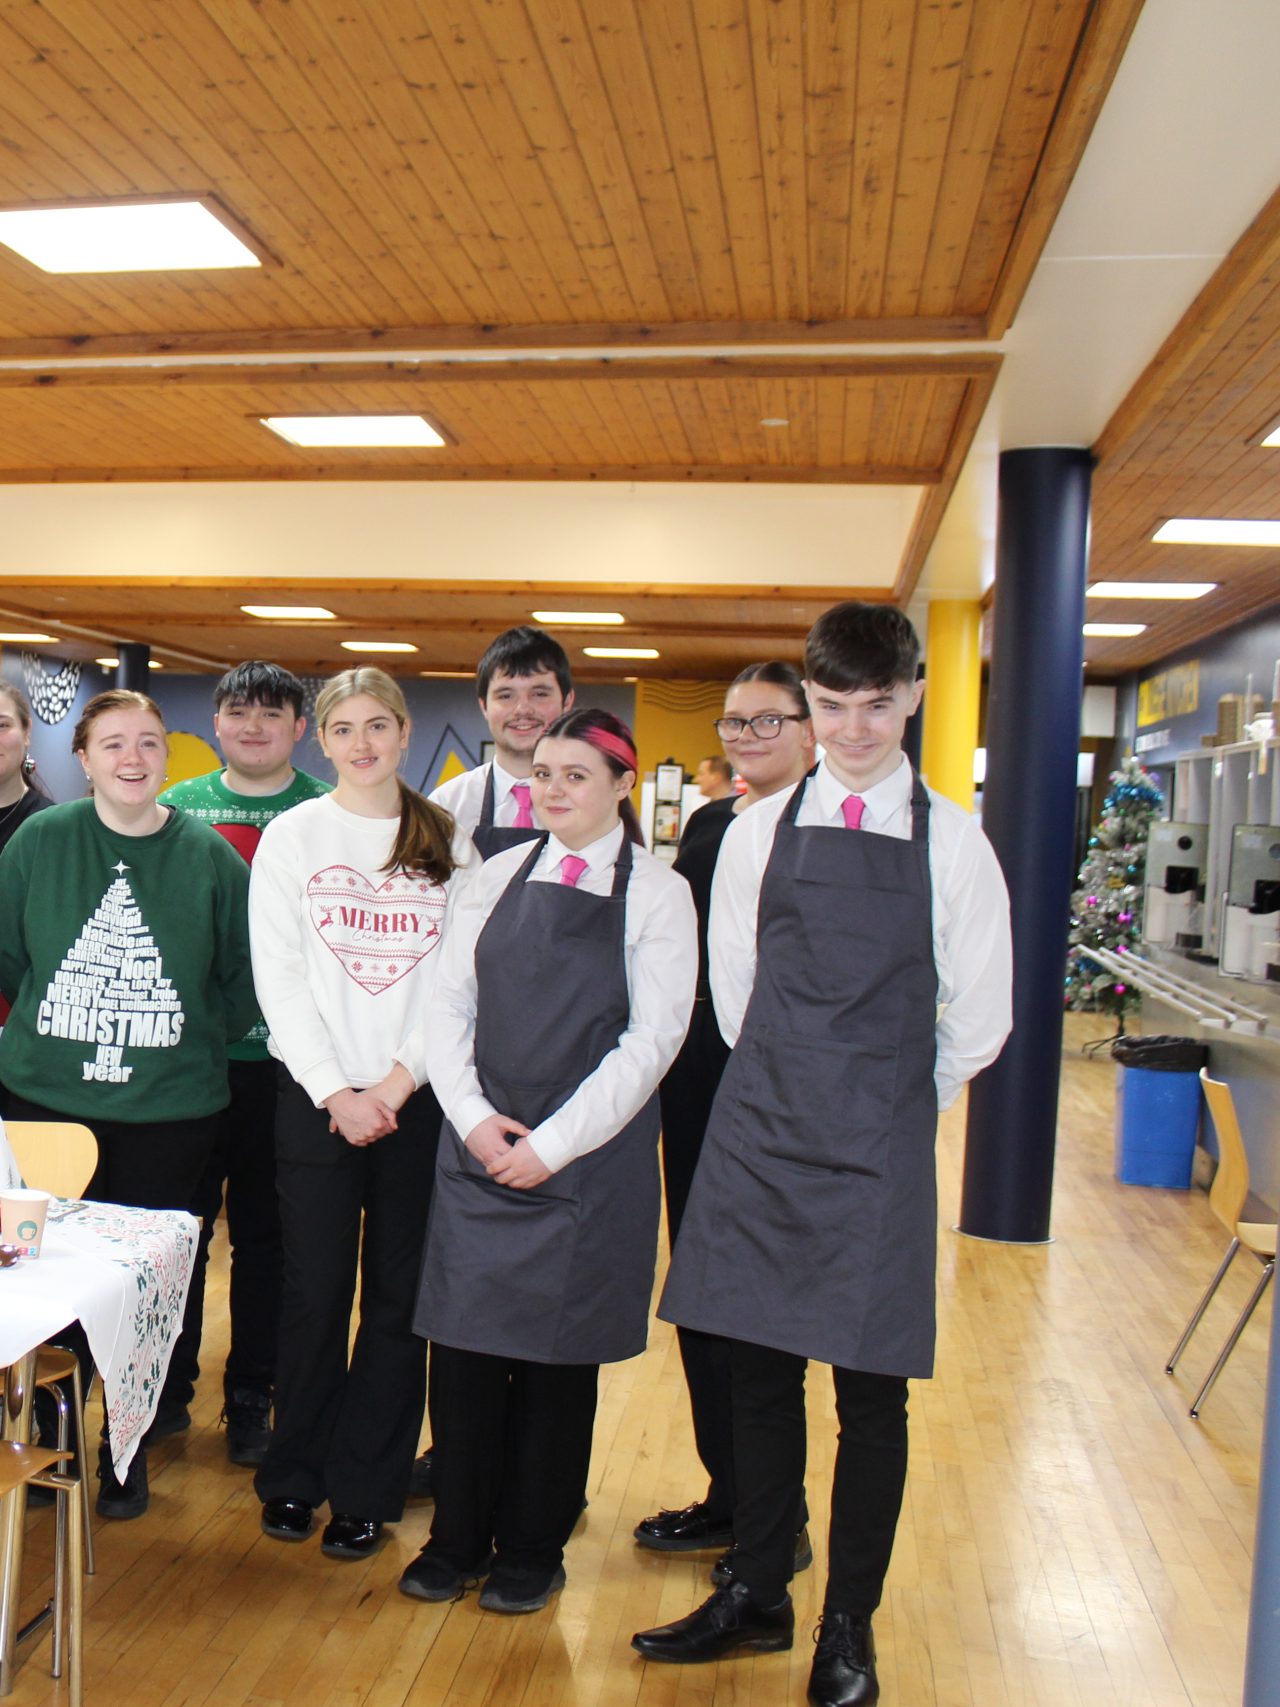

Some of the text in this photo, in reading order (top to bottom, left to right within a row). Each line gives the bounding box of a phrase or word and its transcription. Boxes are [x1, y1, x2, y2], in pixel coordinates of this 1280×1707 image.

[339, 906, 423, 933] MERRY
[74, 938, 108, 954] MERRY
[352, 928, 405, 942] Christmas
[67, 948, 162, 980] CHRISTMAS Noel
[54, 970, 106, 990] HOLIDAYS
[131, 979, 154, 990] LOVE
[46, 983, 102, 1009] MERRY
[36, 1000, 185, 1048] CHRISTMAS
[95, 1044, 124, 1067] NEW
[82, 1061, 133, 1083] year
